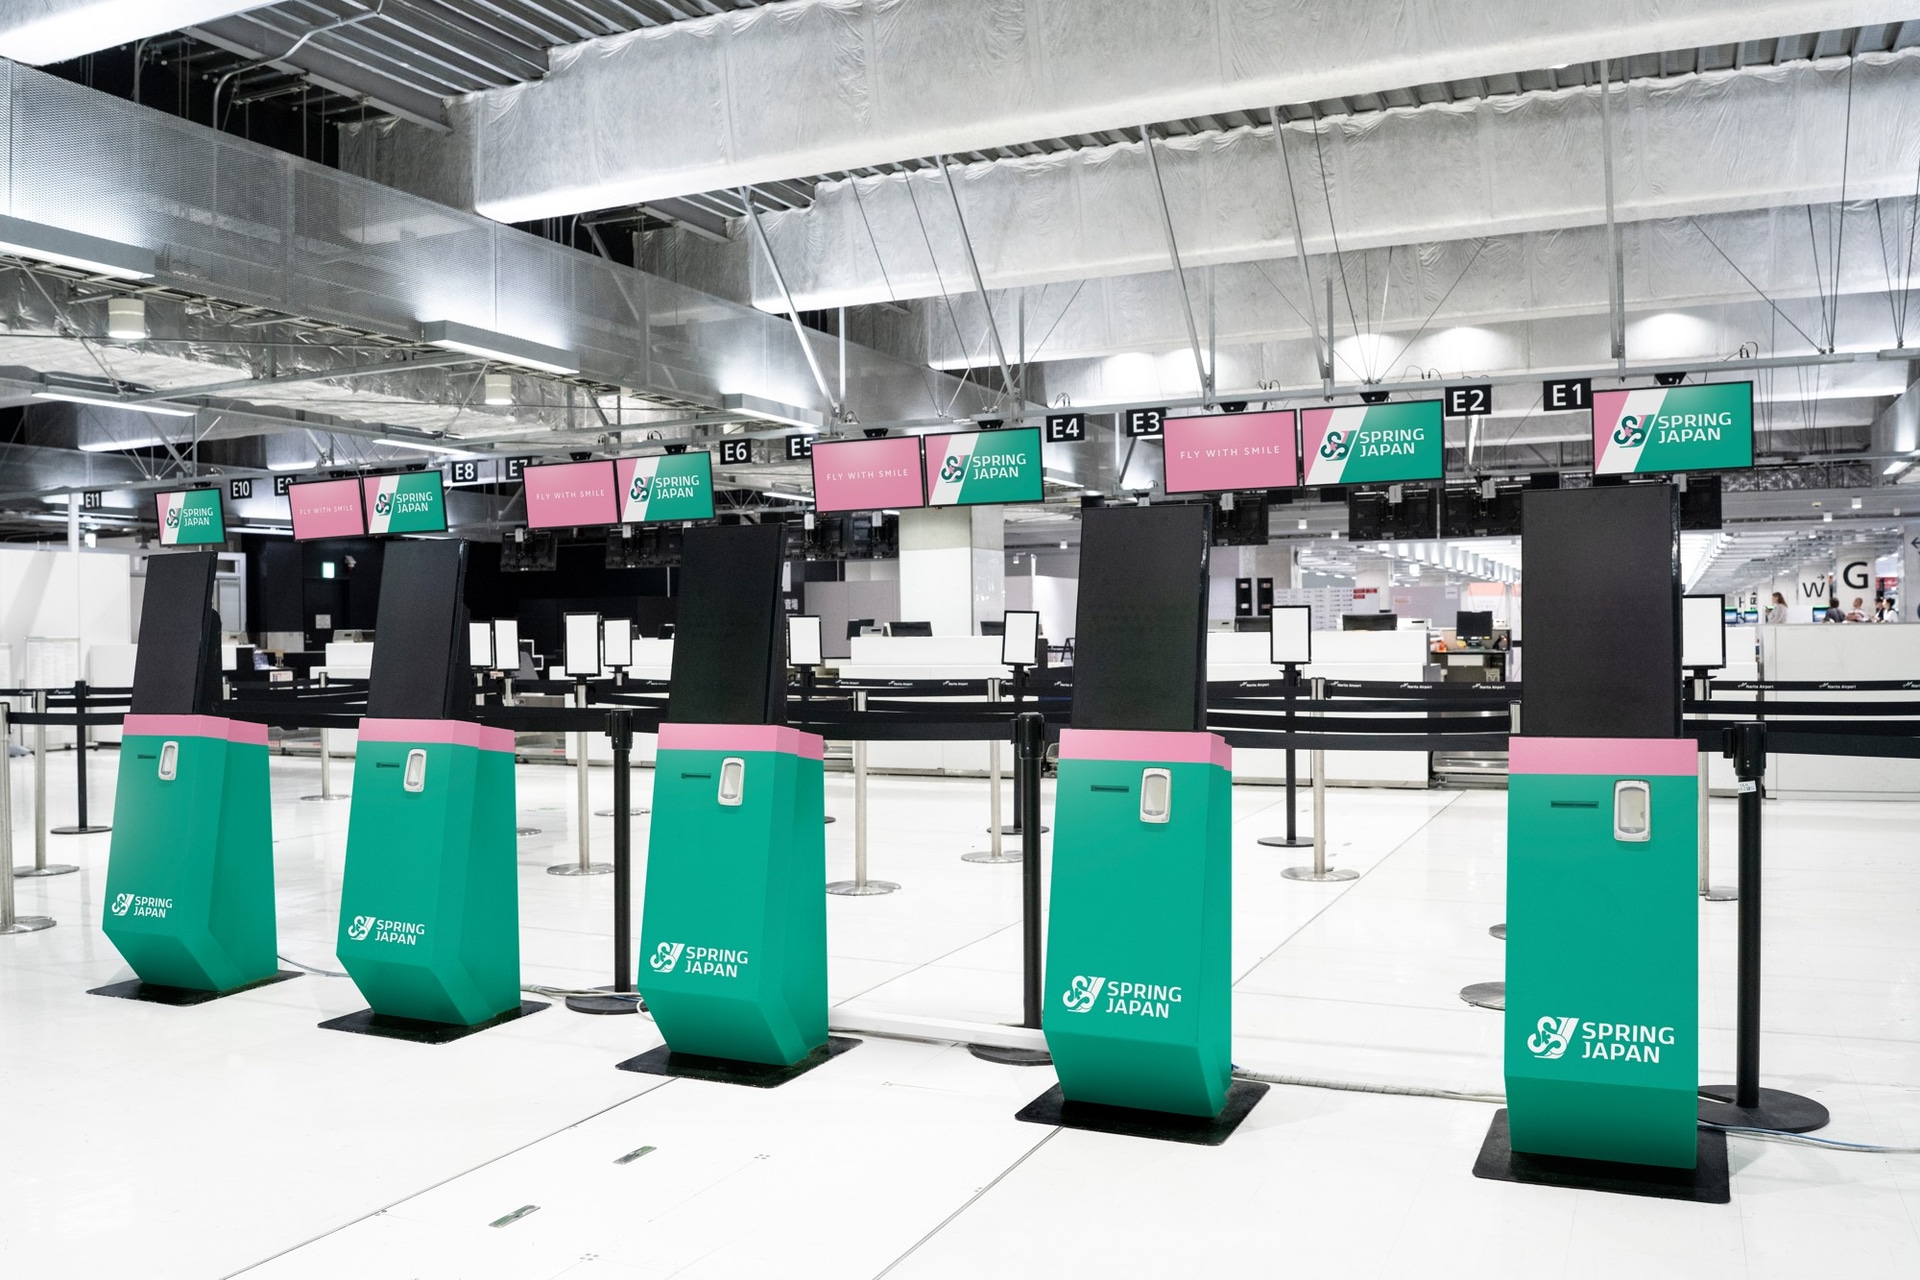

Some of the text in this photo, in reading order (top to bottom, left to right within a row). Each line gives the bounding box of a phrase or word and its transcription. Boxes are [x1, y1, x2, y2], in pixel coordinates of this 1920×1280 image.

[1453, 389, 1484, 412] E2
[1552, 383, 1582, 407] E1
[1052, 418, 1080, 438] E4
[1132, 412, 1160, 433] E3
[1658, 412, 1732, 429] SPRING
[1359, 428, 1425, 444] SPRING
[1658, 427, 1721, 444] JAPAN
[724, 442, 747, 461] E6
[790, 436, 814, 457] E5
[1180, 446, 1280, 459] FLY WITH SMILE
[1360, 442, 1415, 457] JAPAN
[972, 453, 1026, 468] SPRING
[455, 463, 474, 480] E8
[826, 468, 908, 481] FLY WITH SMILE
[973, 466, 1019, 480] JAPAN
[232, 481, 250, 497] E10
[655, 474, 700, 488] SPRING
[85, 493, 100, 508] E11
[396, 492, 433, 504] SPRING
[554, 491, 576, 499] WITH
[580, 489, 605, 497] SMILE
[656, 487, 694, 500] JAPAN
[182, 507, 214, 518] SPRING
[314, 505, 331, 513] WITH
[397, 502, 429, 513] JAPAN
[184, 517, 210, 527] JAPAN
[1842, 561, 1868, 589] G
[134, 896, 173, 908] SPRING
[133, 906, 166, 918] JAPAN
[376, 919, 425, 935] SPRING
[375, 931, 416, 945] JAPAN
[686, 946, 748, 964] SPRING
[685, 960, 738, 978] JAPAN
[1107, 981, 1182, 1002] SPRING
[1106, 998, 1169, 1018] JAPAN
[1582, 1022, 1675, 1045] SPRING
[1582, 1041, 1660, 1064] JAPAN
